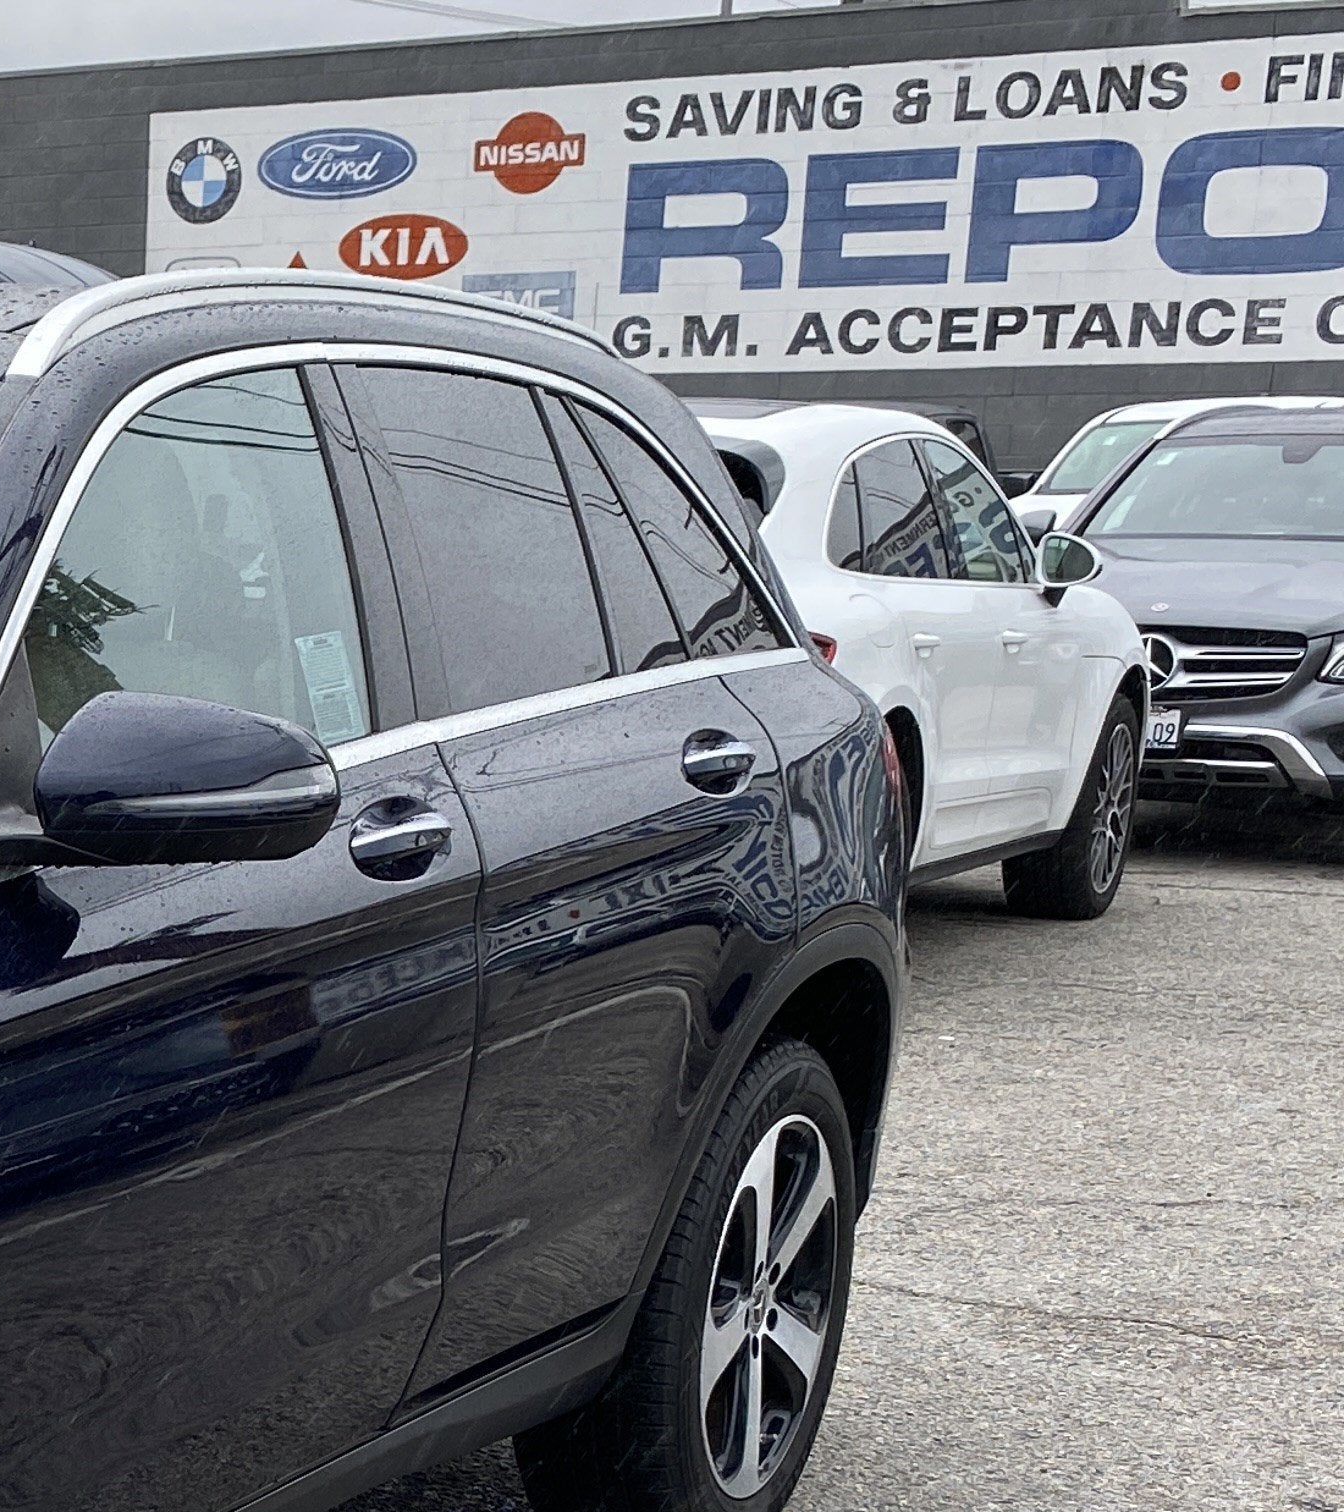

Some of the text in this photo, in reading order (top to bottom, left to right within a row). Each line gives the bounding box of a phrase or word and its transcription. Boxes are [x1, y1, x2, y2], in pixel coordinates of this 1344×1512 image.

[624, 83, 863, 142] SAVING
[892, 78, 931, 125] &
[954, 61, 1189, 122] LOANS
[171, 139, 239, 178] BMW
[291, 142, 381, 184] Ford
[479, 140, 580, 167] NISSAN
[619, 126, 1344, 294] REPO
[358, 226, 450, 266] KIA
[612, 313, 759, 359] G.M.
[785, 298, 1287, 355] ACCEPTANCE
